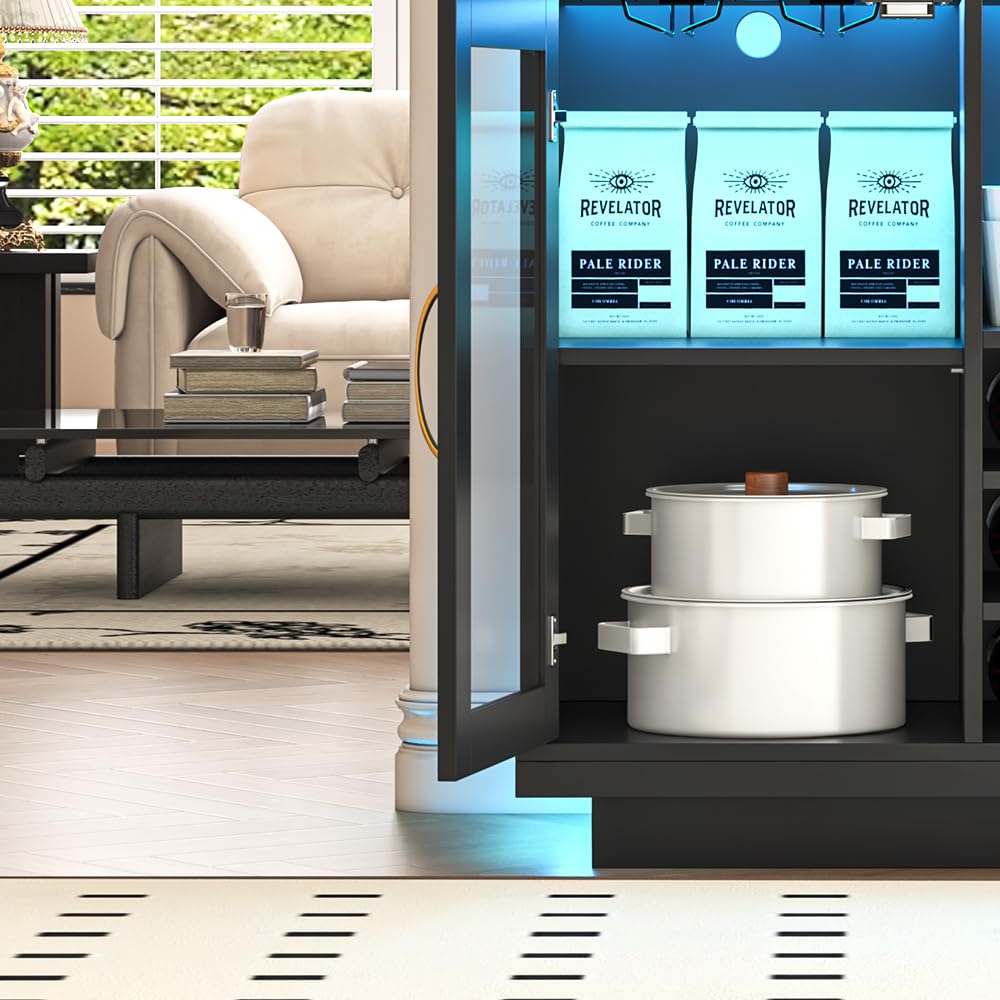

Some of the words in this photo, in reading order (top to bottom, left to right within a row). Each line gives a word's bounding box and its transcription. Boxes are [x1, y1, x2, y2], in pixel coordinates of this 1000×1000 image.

[580, 199, 661, 218] REVELATOR
[714, 199, 795, 218] REVELATOR
[848, 199, 929, 218] REVELATOR
[579, 258, 613, 270] PALE
[618, 258, 662, 270] RIDER
[713, 258, 747, 270] PALE
[752, 258, 796, 270] RIDER
[847, 258, 881, 270] PALE
[886, 258, 930, 270] RIDER
